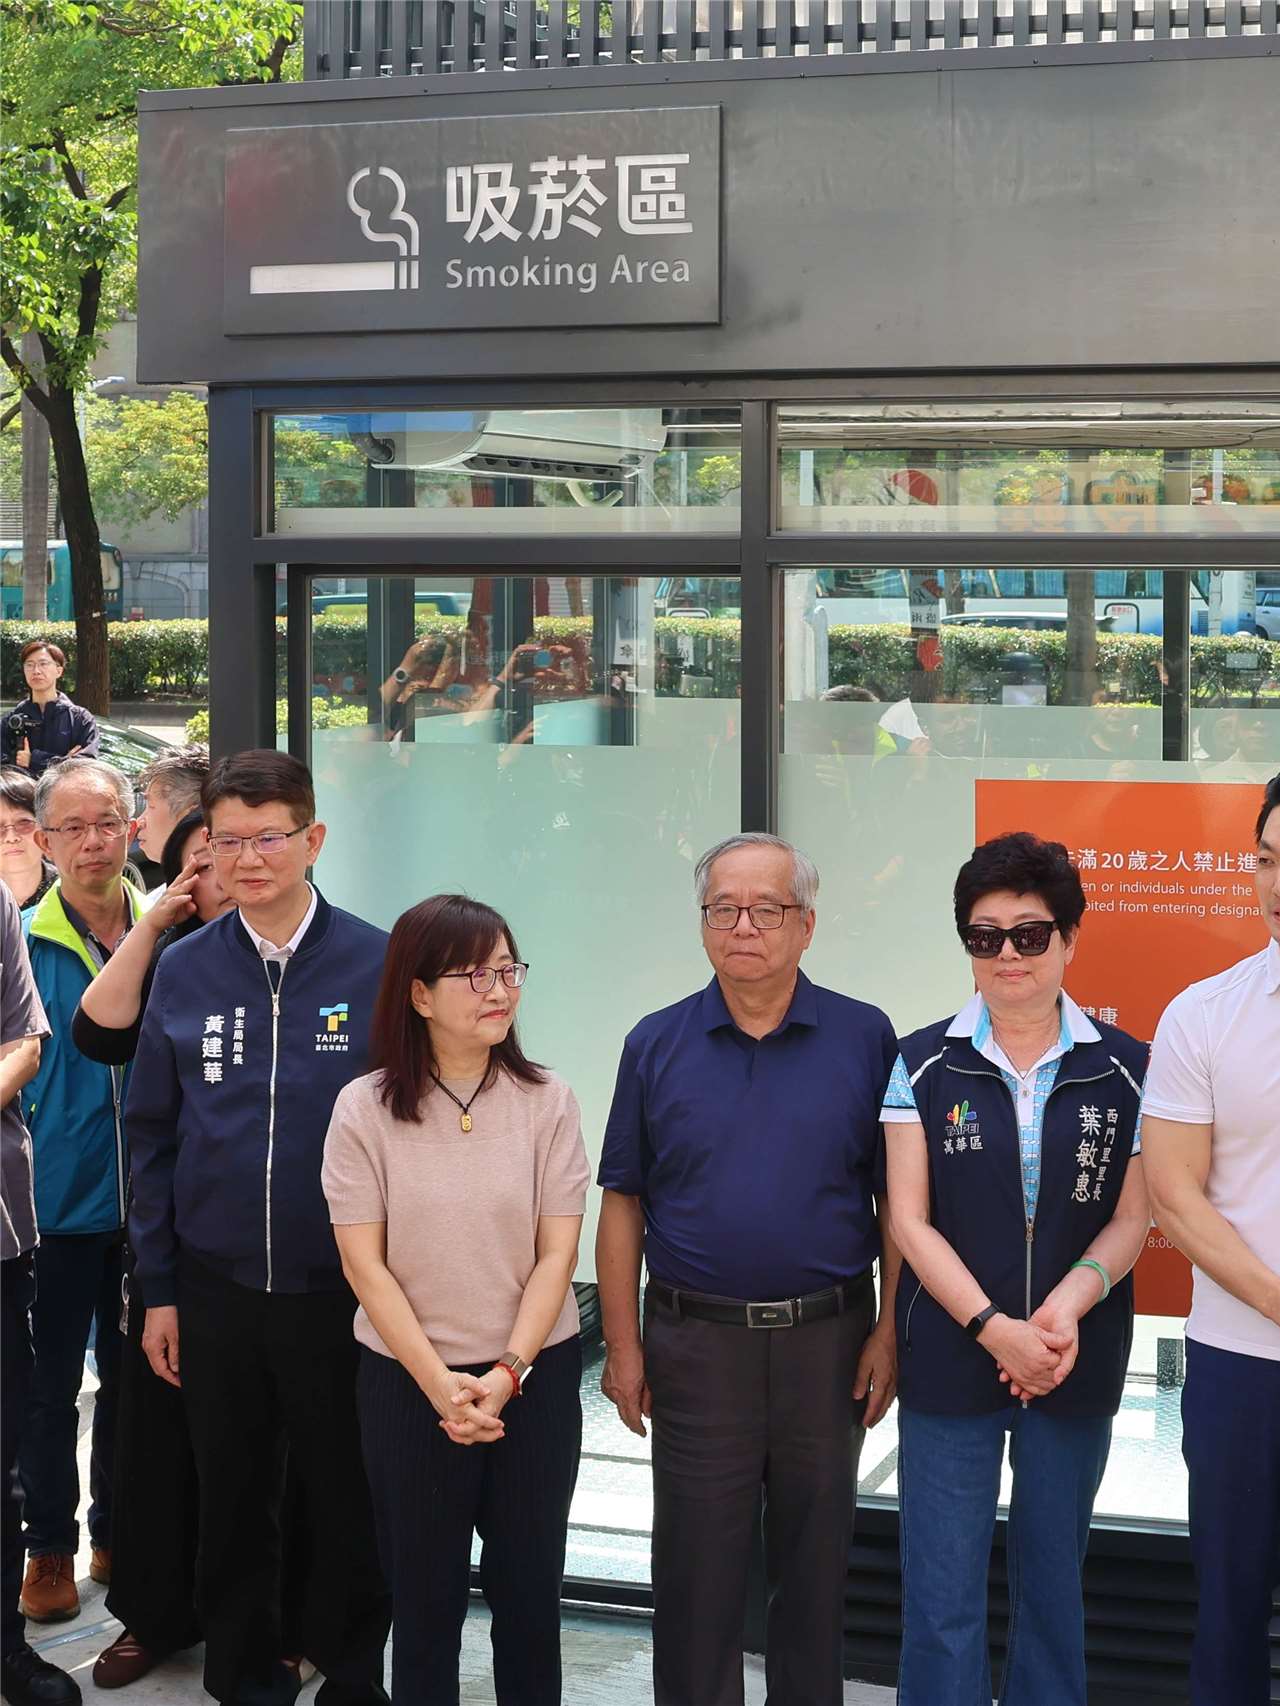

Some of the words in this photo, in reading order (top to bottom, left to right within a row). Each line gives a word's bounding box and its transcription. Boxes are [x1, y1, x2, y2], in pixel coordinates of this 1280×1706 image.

[446, 153, 694, 244] 吸菸區
[446, 255, 598, 293] Smoking
[609, 254, 690, 284] Area
[1101, 883, 1114, 893] or
[1119, 881, 1185, 895] individuals
[1190, 883, 1228, 896] under
[1232, 884, 1252, 897] the
[1119, 900, 1148, 913] from
[1153, 902, 1206, 917] entering
[202, 1014, 225, 1085] 黃建華
[232, 1006, 246, 1066] 衛生局局長
[315, 1034, 349, 1043] TAIPEI
[943, 1136, 984, 1155] 萬華區
[944, 1123, 980, 1137] TAIPEI
[1071, 1104, 1103, 1203] 葉敏惠
[1093, 1108, 1119, 1201] 西門里里長
